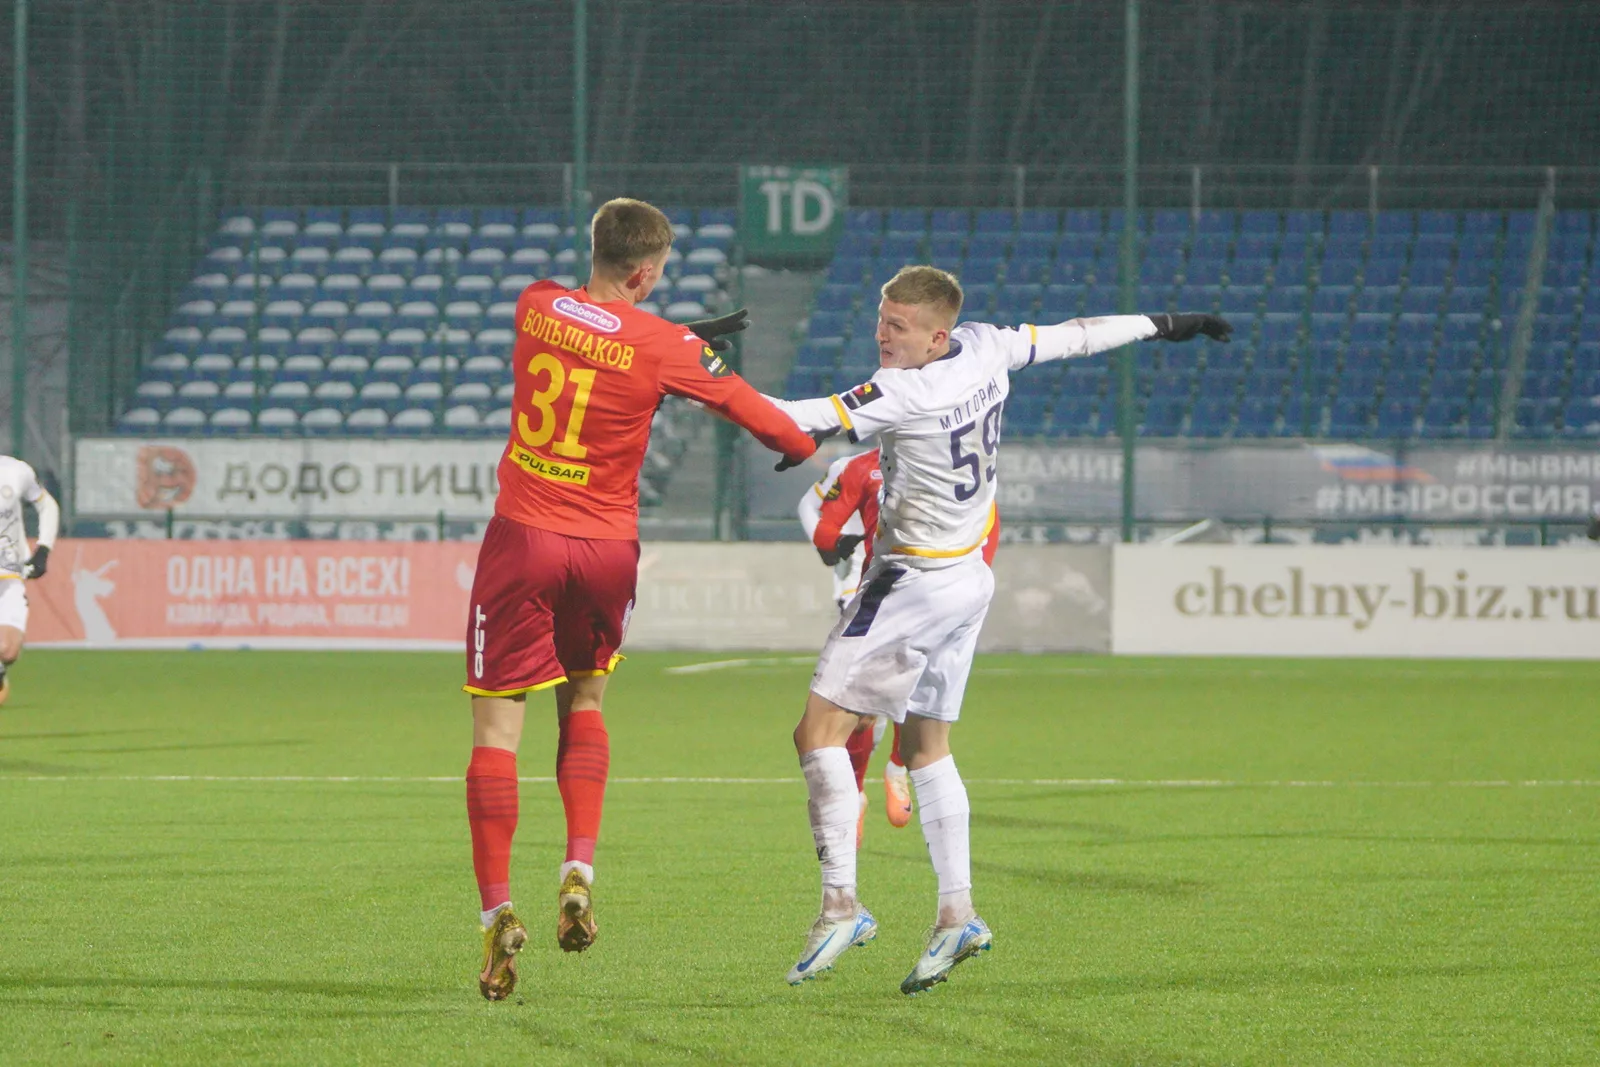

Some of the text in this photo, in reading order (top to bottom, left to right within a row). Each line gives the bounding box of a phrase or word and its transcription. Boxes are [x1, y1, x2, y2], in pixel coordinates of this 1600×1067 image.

[522, 308, 635, 370] БОЛЬШАКОВ
[517, 352, 597, 459] 31
[519, 453, 586, 480] PULSAR
[950, 401, 1003, 502] 59
[217, 462, 362, 501] ДОДО
[1315, 483, 1591, 516] #МЫРОССИЯ
[167, 554, 410, 600] ОДНА НА ВСЕХ!
[1173, 566, 1600, 632] chelny-biz.ru
